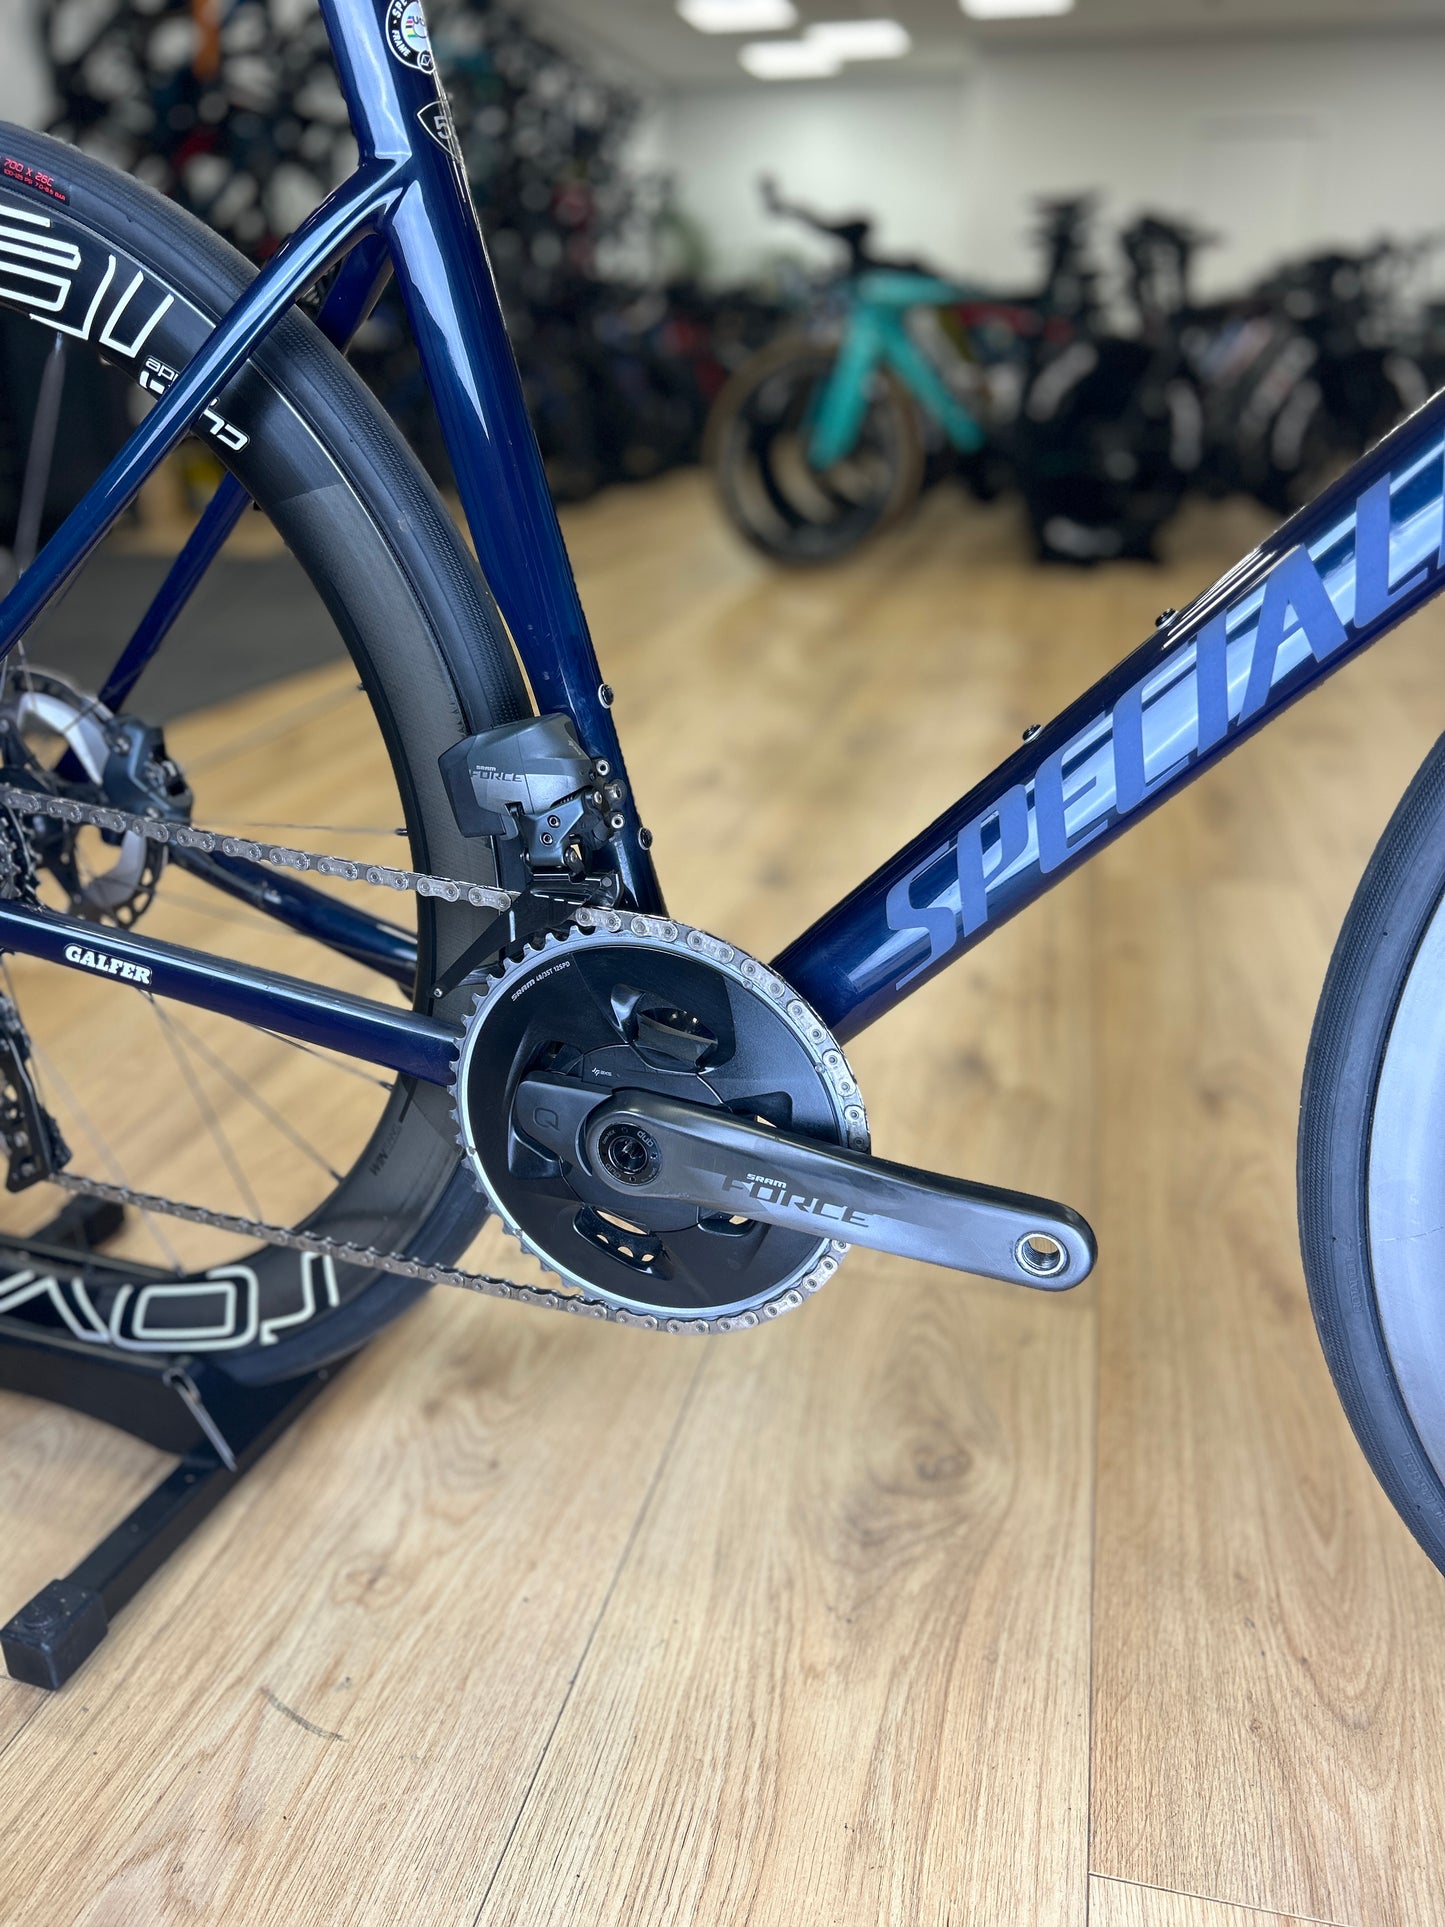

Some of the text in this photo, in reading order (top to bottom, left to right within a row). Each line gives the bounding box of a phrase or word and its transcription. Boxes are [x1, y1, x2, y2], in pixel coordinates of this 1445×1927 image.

[392, 29, 411, 57] FRAME
[433, 115, 453, 140] 5
[4, 158, 24, 172] 700
[35, 171, 54, 187] 26C
[886, 428, 1445, 991] SPECIAL
[470, 769, 522, 783] FORCE
[65, 945, 151, 985] GALFER
[511, 978, 535, 1002] SRAM
[746, 1172, 788, 1189] SRAM
[721, 1174, 870, 1228] FORCE
